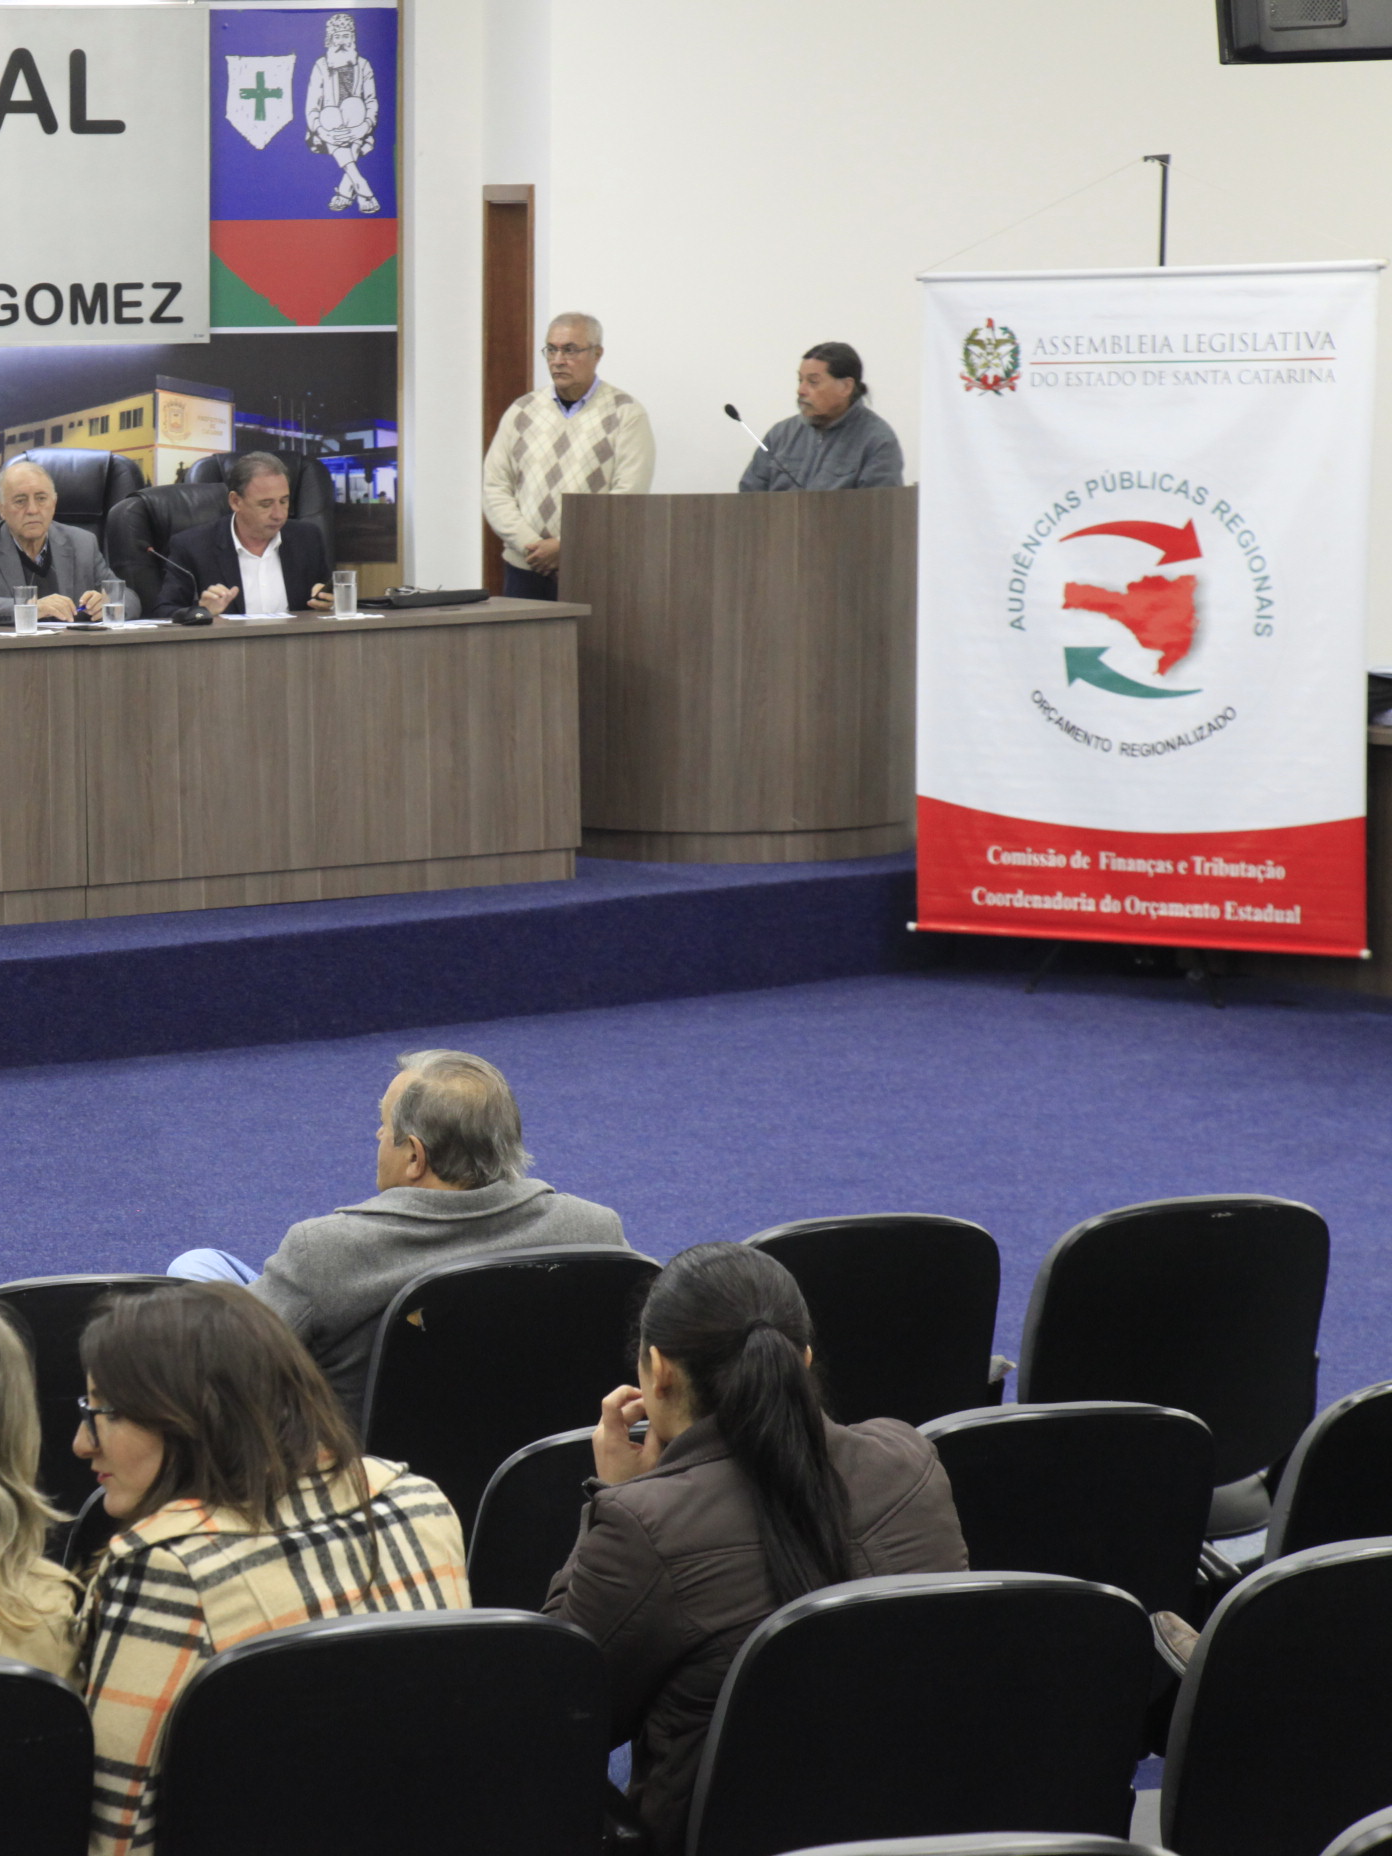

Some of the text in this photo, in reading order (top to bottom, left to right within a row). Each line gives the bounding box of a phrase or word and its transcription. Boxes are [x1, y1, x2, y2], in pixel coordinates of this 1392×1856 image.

[1033, 331, 1337, 356] ASSEMBLEIA LEGISLATIVA
[1030, 367, 1337, 388] DO ESTADO DE SANTA CATARINA
[1009, 469, 1274, 638] AUDIÊNCIAS PÚBLICAS REGIONAIS
[1031, 689, 1237, 758] ORÇAMENTO REGIONALIZADO
[986, 845, 1286, 882] Comissão de Finanças e Tributação
[971, 886, 1301, 924] Coordenadoria do Orçamento Estadual
